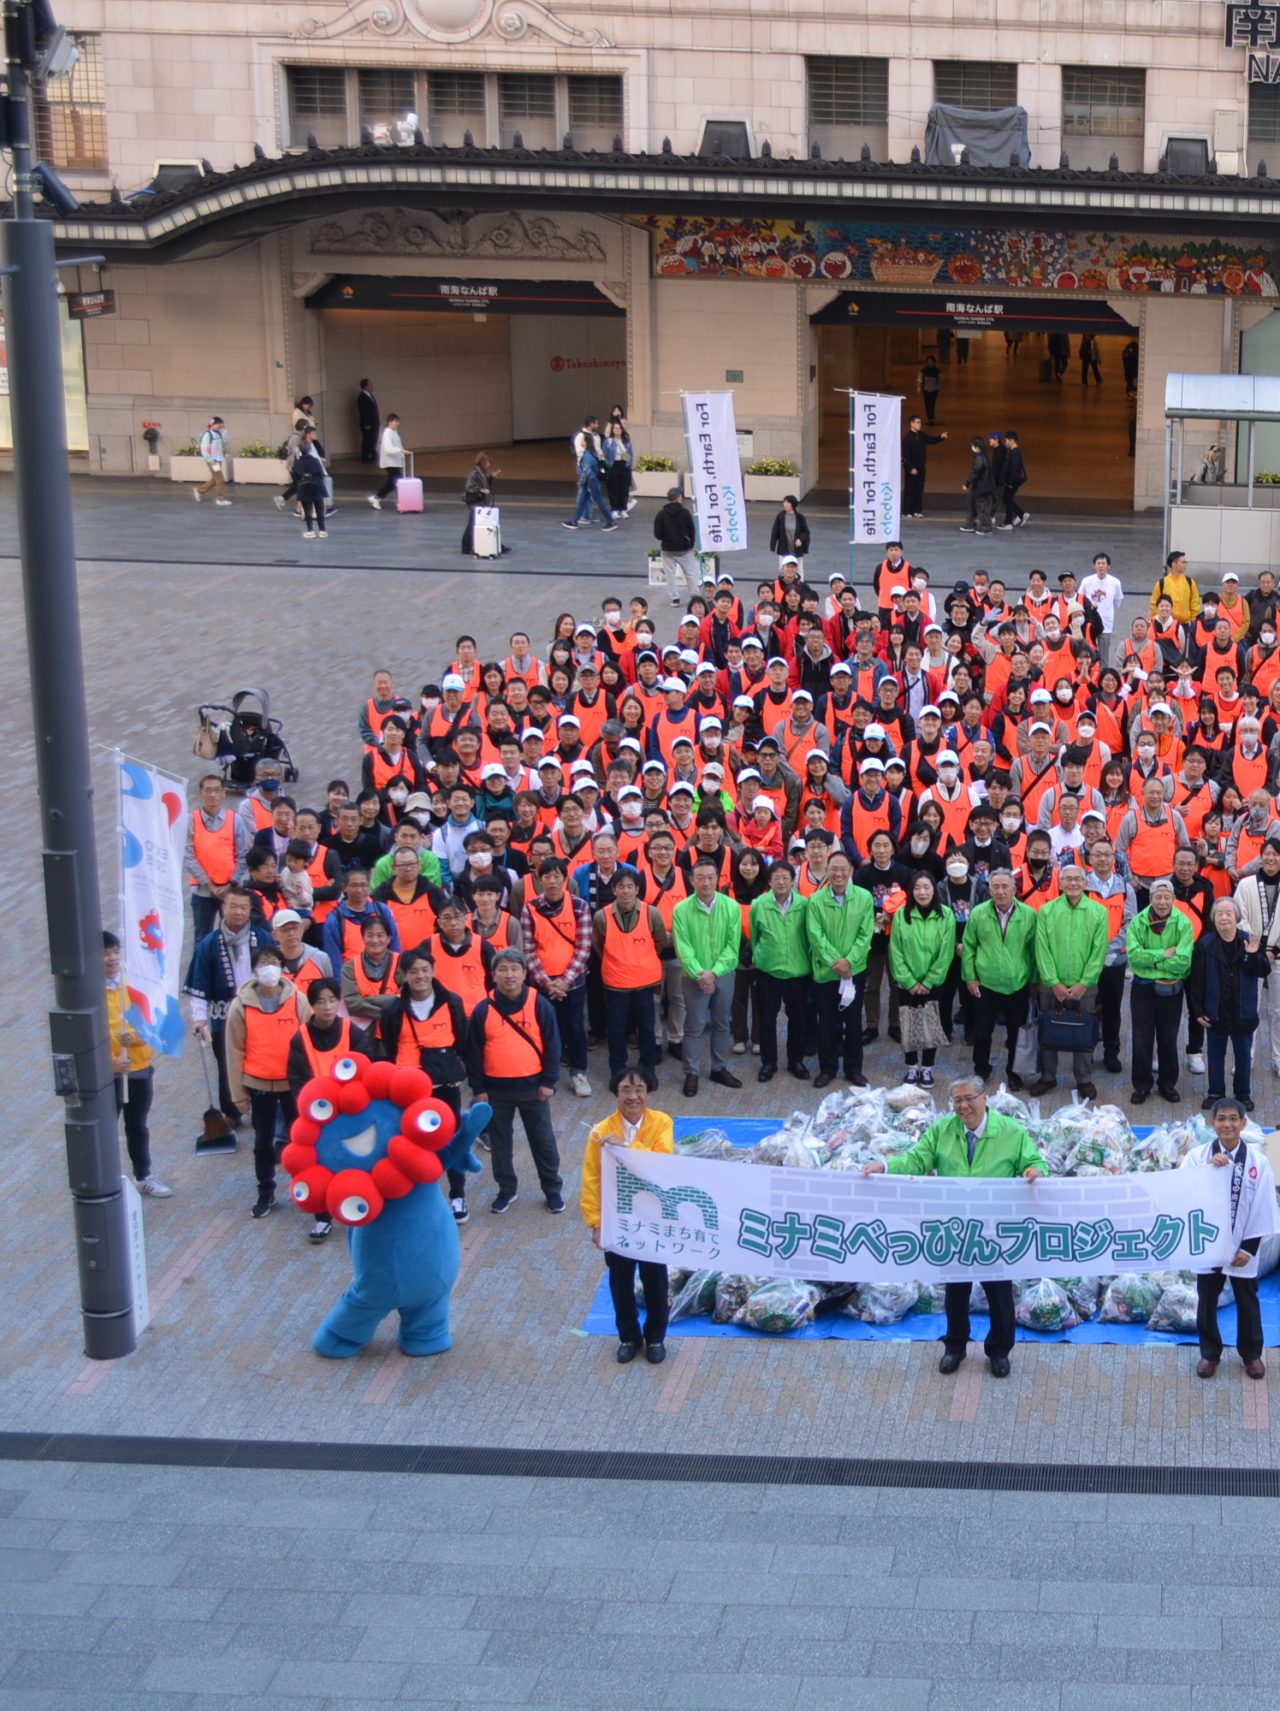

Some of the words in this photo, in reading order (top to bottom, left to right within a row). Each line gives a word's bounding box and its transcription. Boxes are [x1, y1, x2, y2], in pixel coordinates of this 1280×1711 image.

[440, 284, 498, 297] 南海なんば駅
[945, 302, 1004, 314] 南海なんば駅
[617, 1217, 720, 1246] ミナミまち育て
[738, 1207, 1220, 1267] ミナミべっぴんプロジェクト
[616, 1234, 721, 1260] ネットワーク
